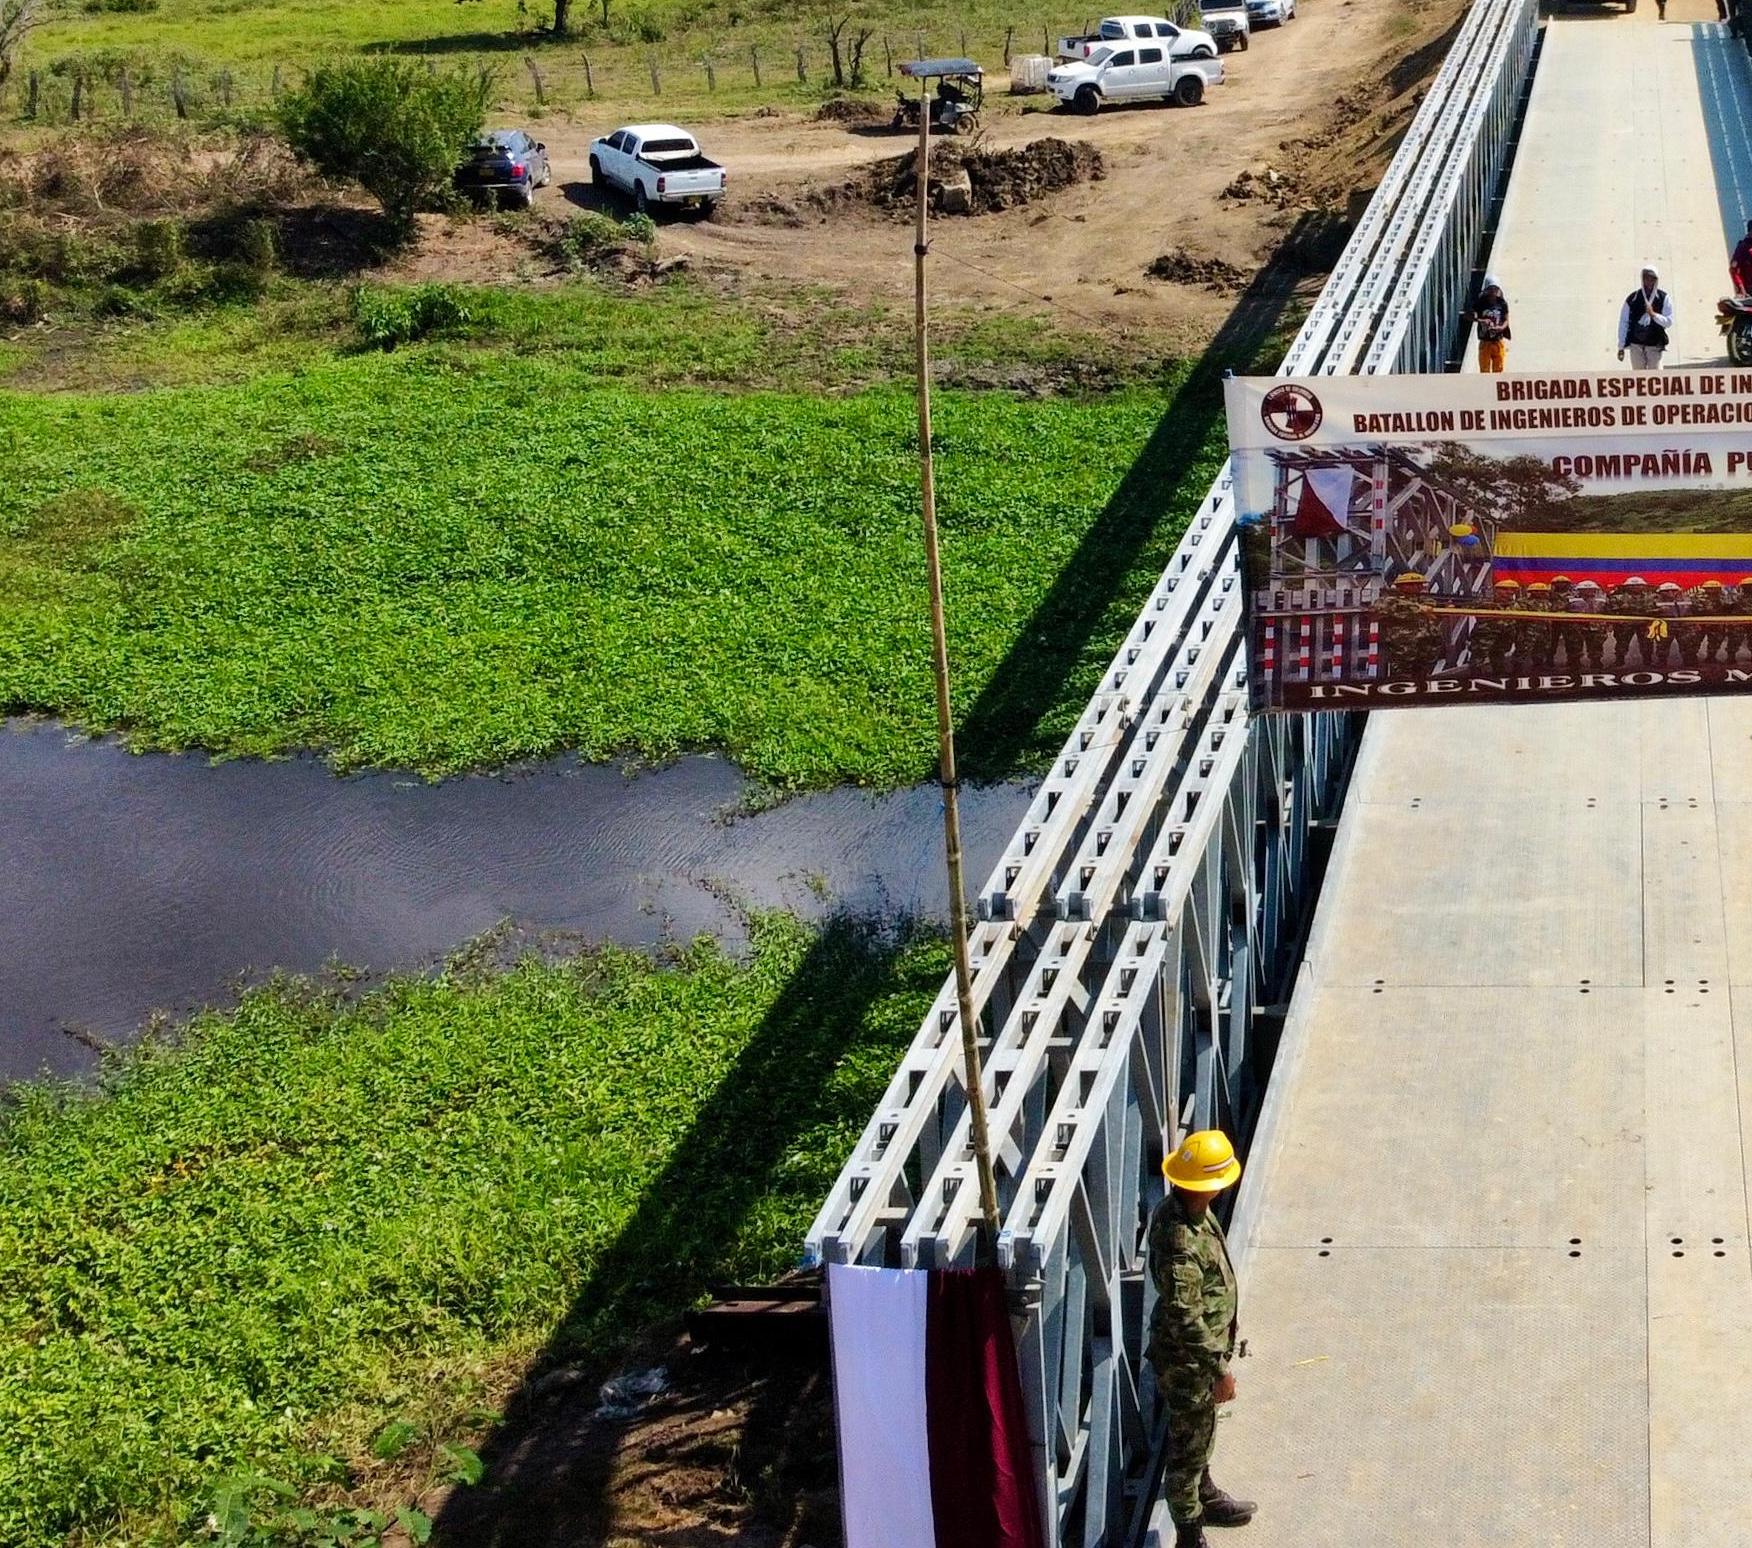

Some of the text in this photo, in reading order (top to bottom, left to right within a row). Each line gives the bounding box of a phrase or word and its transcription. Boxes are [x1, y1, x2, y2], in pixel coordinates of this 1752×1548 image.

[1495, 378, 1591, 401] BRIGADA
[1597, 376, 1693, 399] ESPECIAL
[1699, 375, 1725, 395] DE
[1353, 410, 1454, 433] BATALLON
[1460, 409, 1486, 431] DE
[1490, 406, 1616, 430] INGENIEROS
[1621, 405, 1647, 426] DE
[1551, 447, 1713, 476] COMPAÑÍA
[1309, 669, 1702, 698] INGENIEROS
